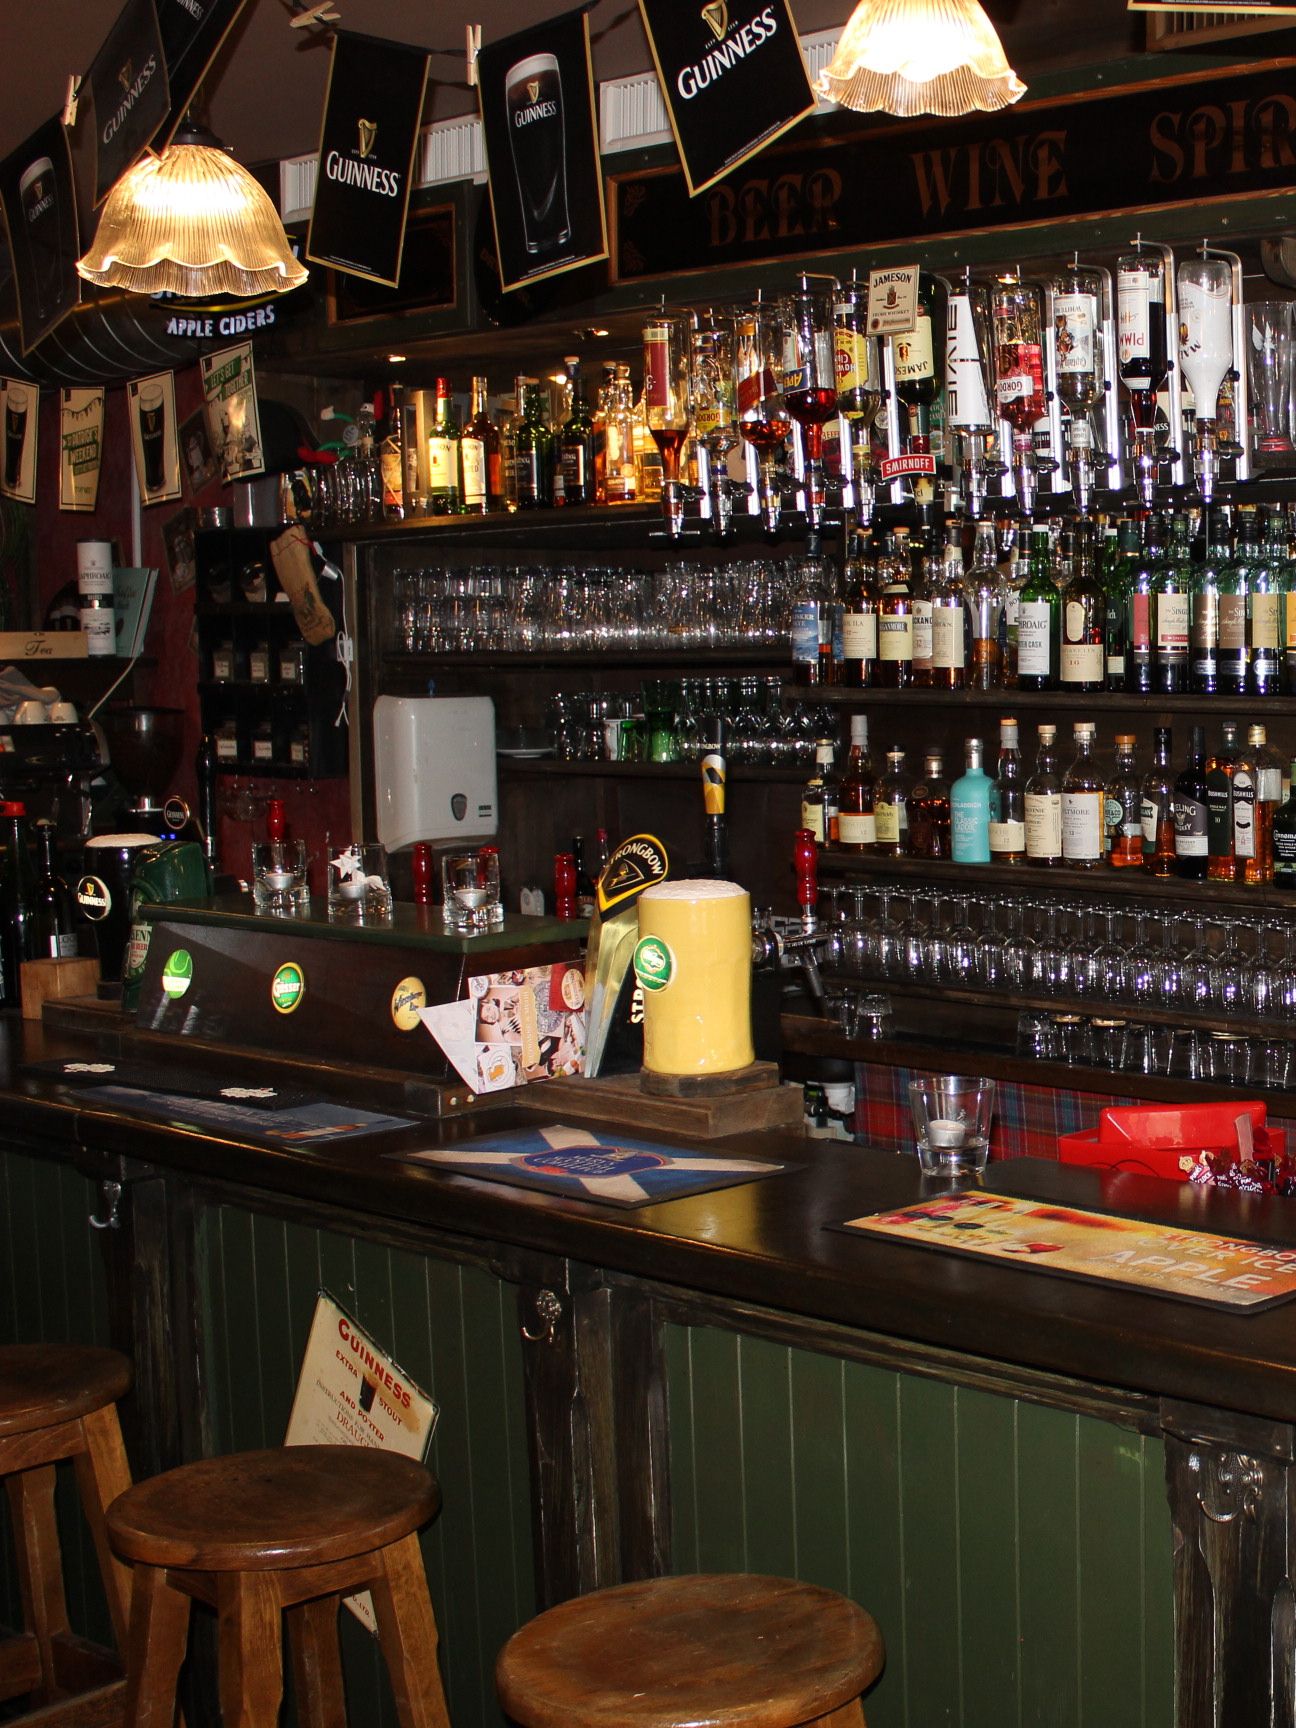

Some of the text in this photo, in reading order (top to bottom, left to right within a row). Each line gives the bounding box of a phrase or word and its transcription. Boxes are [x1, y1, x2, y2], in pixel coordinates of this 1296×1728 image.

[677, 8, 777, 99] GUINNESS
[103, 54, 157, 144] GUINNESS
[515, 100, 557, 128] GUINNESS
[326, 151, 399, 197] GUINNESS
[708, 167, 843, 247] BEER
[911, 130, 1068, 219] WINE
[873, 272, 913, 289] JAMESON
[167, 305, 275, 337] APPLE CIDERS
[886, 456, 930, 474] SMIRNOFF
[25, 640, 53, 657] Tea
[1029, 640, 1043, 649] CASK
[1208, 790, 1229, 798] BUSHMILLS
[1136, 1236, 1242, 1261] OVER
[1090, 1249, 1273, 1292] APPLE
[338, 1318, 412, 1408] GUINNESS
[335, 1350, 403, 1426] EXTRA STOUT
[339, 1390, 385, 1442] AND PORTER
